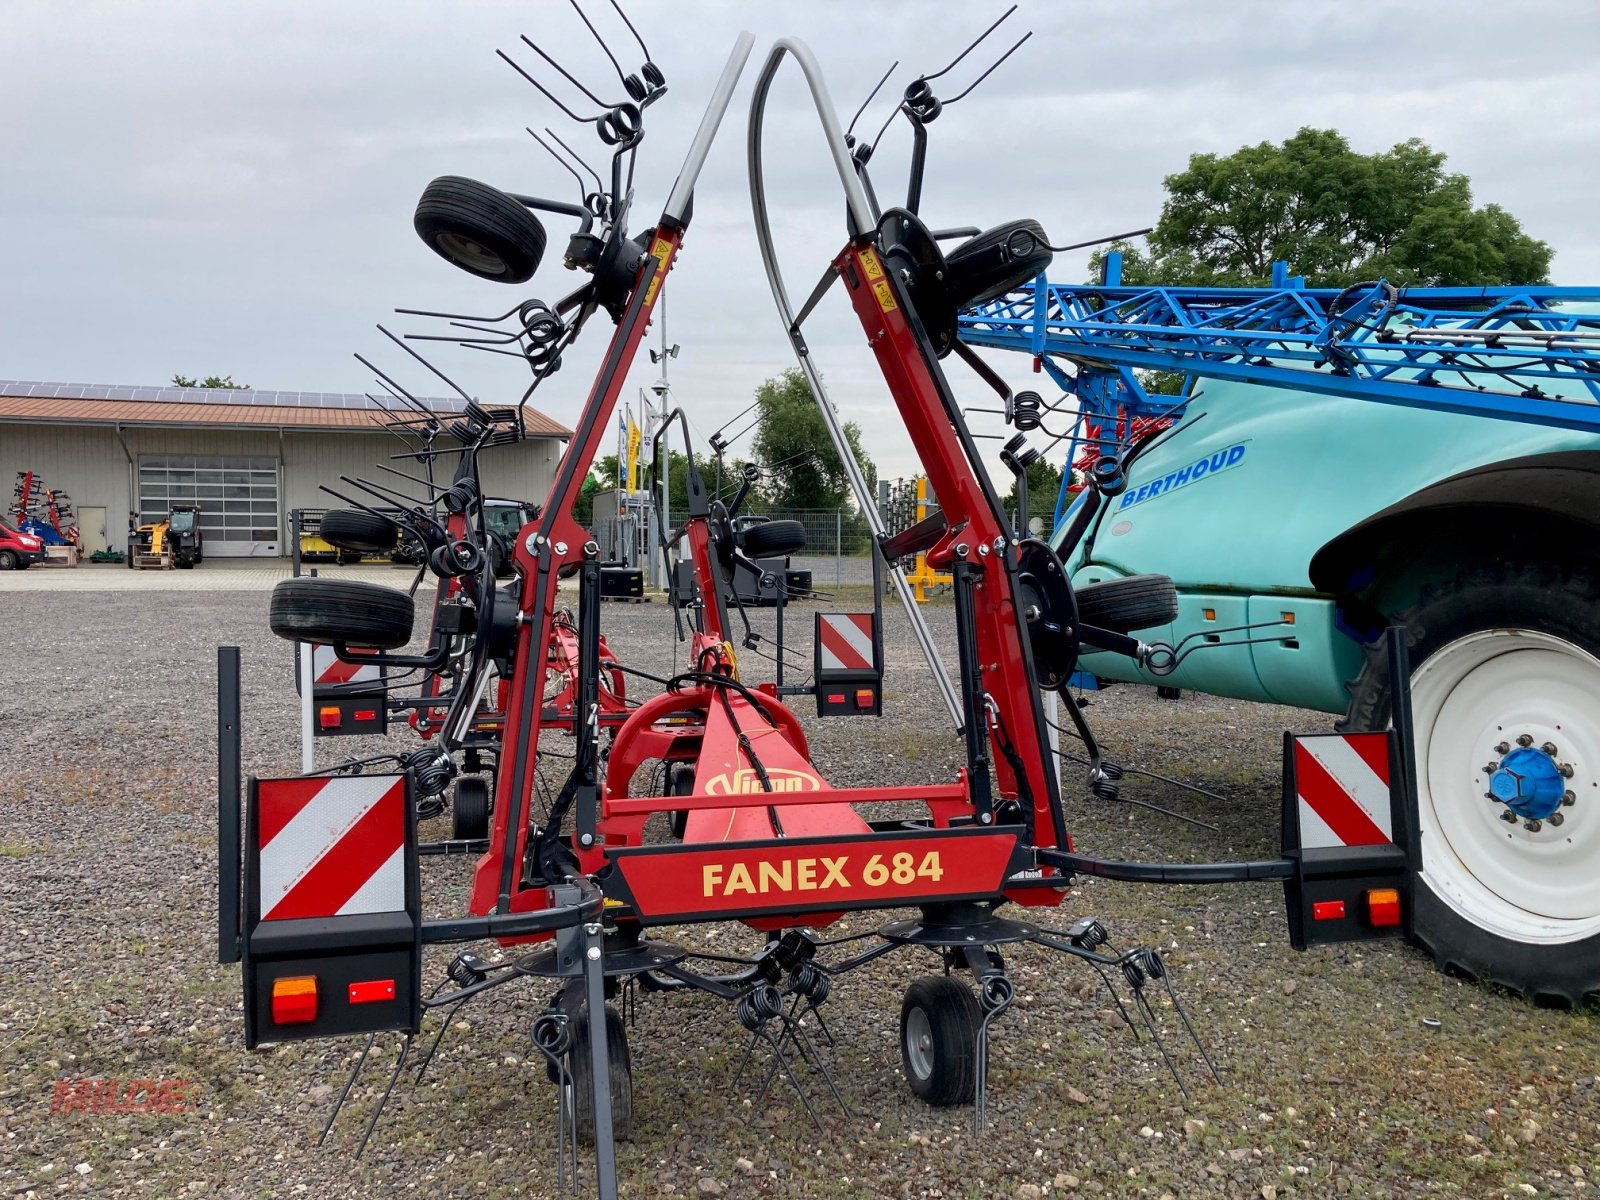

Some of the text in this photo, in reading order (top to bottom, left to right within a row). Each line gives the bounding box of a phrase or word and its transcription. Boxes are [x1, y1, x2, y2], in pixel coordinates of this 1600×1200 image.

[1119, 445, 1246, 510] BERTHOUD
[703, 852, 944, 897] FANEX 684
